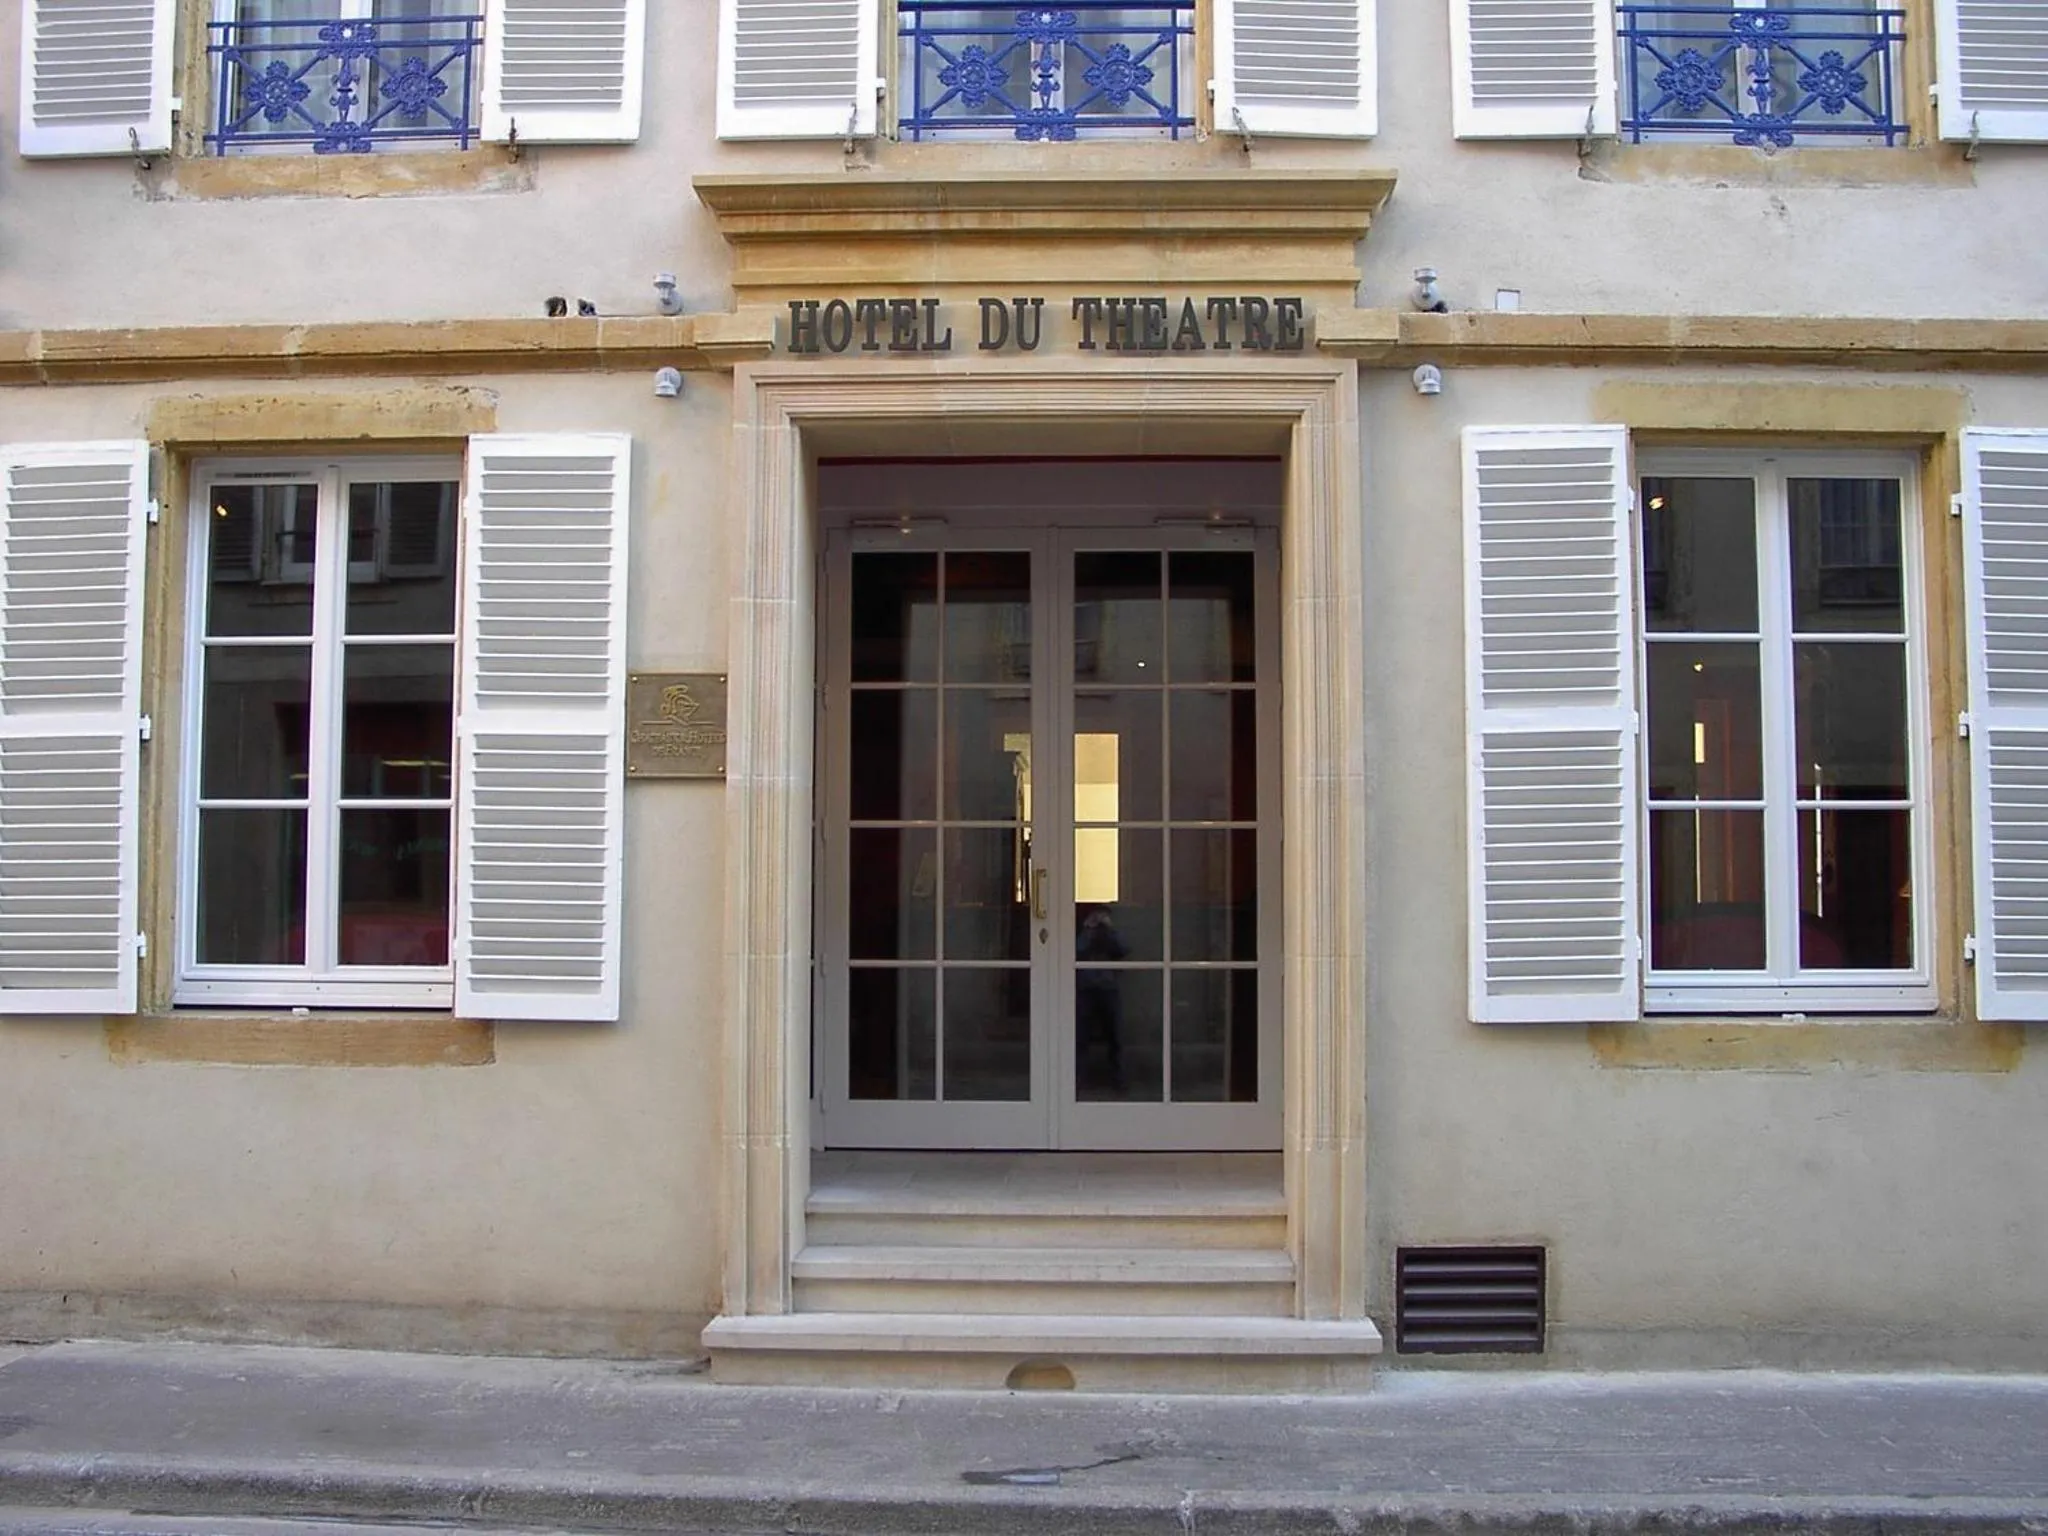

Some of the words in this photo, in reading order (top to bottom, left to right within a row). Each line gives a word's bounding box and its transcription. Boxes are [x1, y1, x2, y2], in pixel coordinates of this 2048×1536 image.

[788, 299, 952, 353] HOTEL
[977, 298, 1045, 351] DU
[1072, 297, 1305, 351] THEATRE
